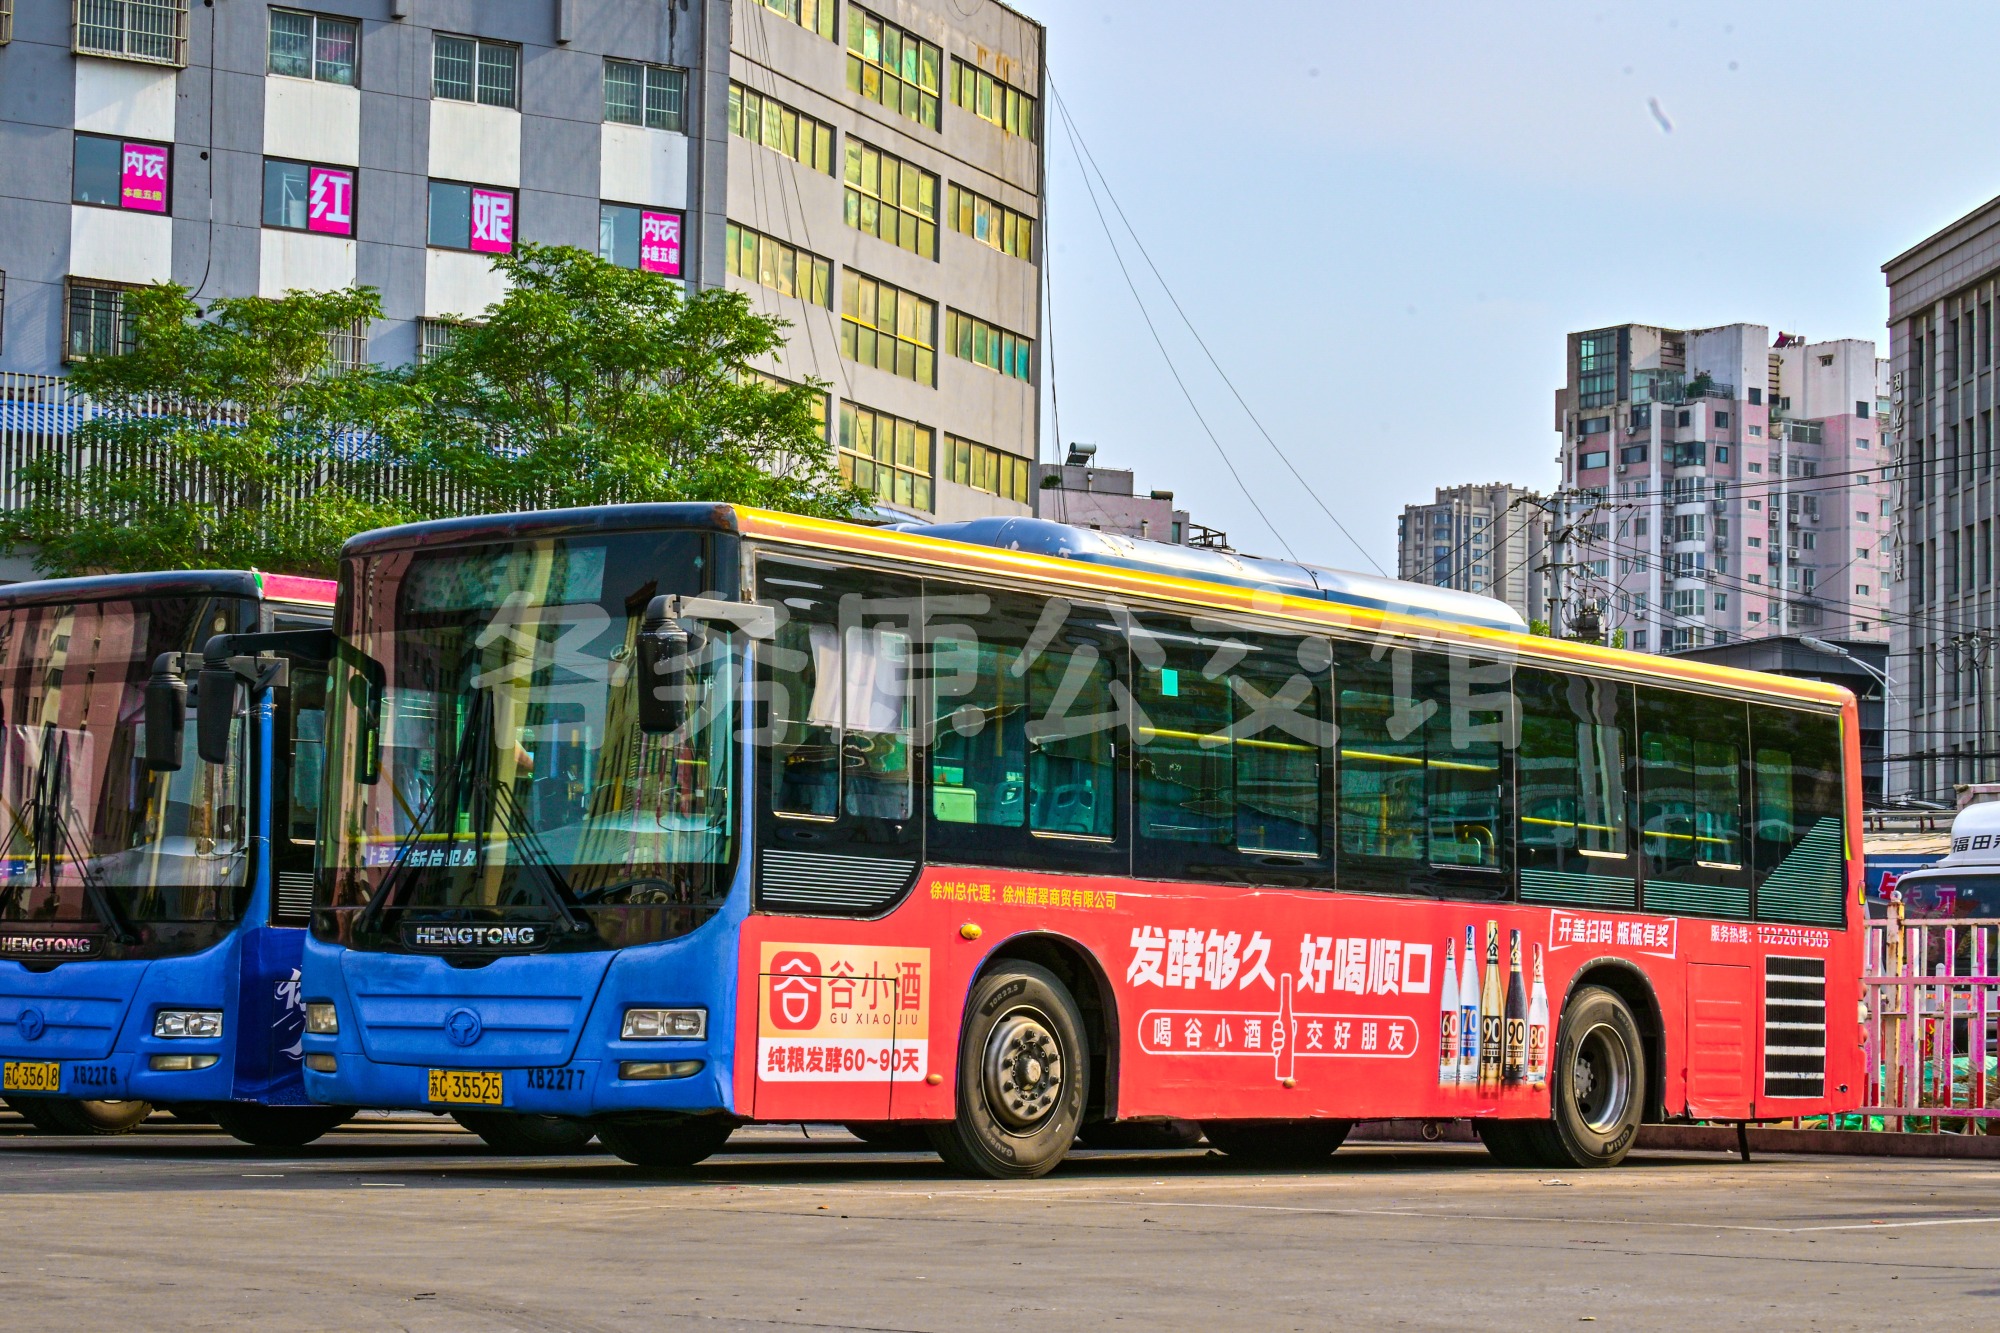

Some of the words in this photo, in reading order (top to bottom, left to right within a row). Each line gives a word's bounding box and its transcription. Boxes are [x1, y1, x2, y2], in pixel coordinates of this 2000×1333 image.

[123, 151, 165, 180] 内衣
[309, 173, 350, 224] 红
[472, 192, 511, 243] 妮
[641, 215, 679, 243] 内衣
[641, 244, 679, 264] 本座五楼
[1, 936, 91, 953] HENGTONG
[415, 927, 535, 945] HENGTONG
[1558, 917, 1613, 945] 开盖扫码
[1616, 920, 1670, 948] 瓶瓶有奖
[1126, 924, 1275, 992] 发酵够久
[1297, 933, 1433, 996] 好喝顺口
[827, 960, 922, 1011] 谷小酒
[830, 1012, 848, 1025] GU
[856, 1013, 891, 1025] XIAO
[897, 1014, 918, 1026] JIU
[1442, 1014, 1458, 1037] 60
[1462, 1008, 1477, 1033] 70
[1483, 1017, 1501, 1043] 90
[1153, 1017, 1262, 1049] 喝谷小酒
[1306, 1020, 1405, 1051] 交好朋友
[1507, 1021, 1524, 1045] 90
[1529, 1026, 1546, 1049] 80
[73, 1066, 117, 1086] XB2276
[527, 1068, 586, 1091] XB2277
